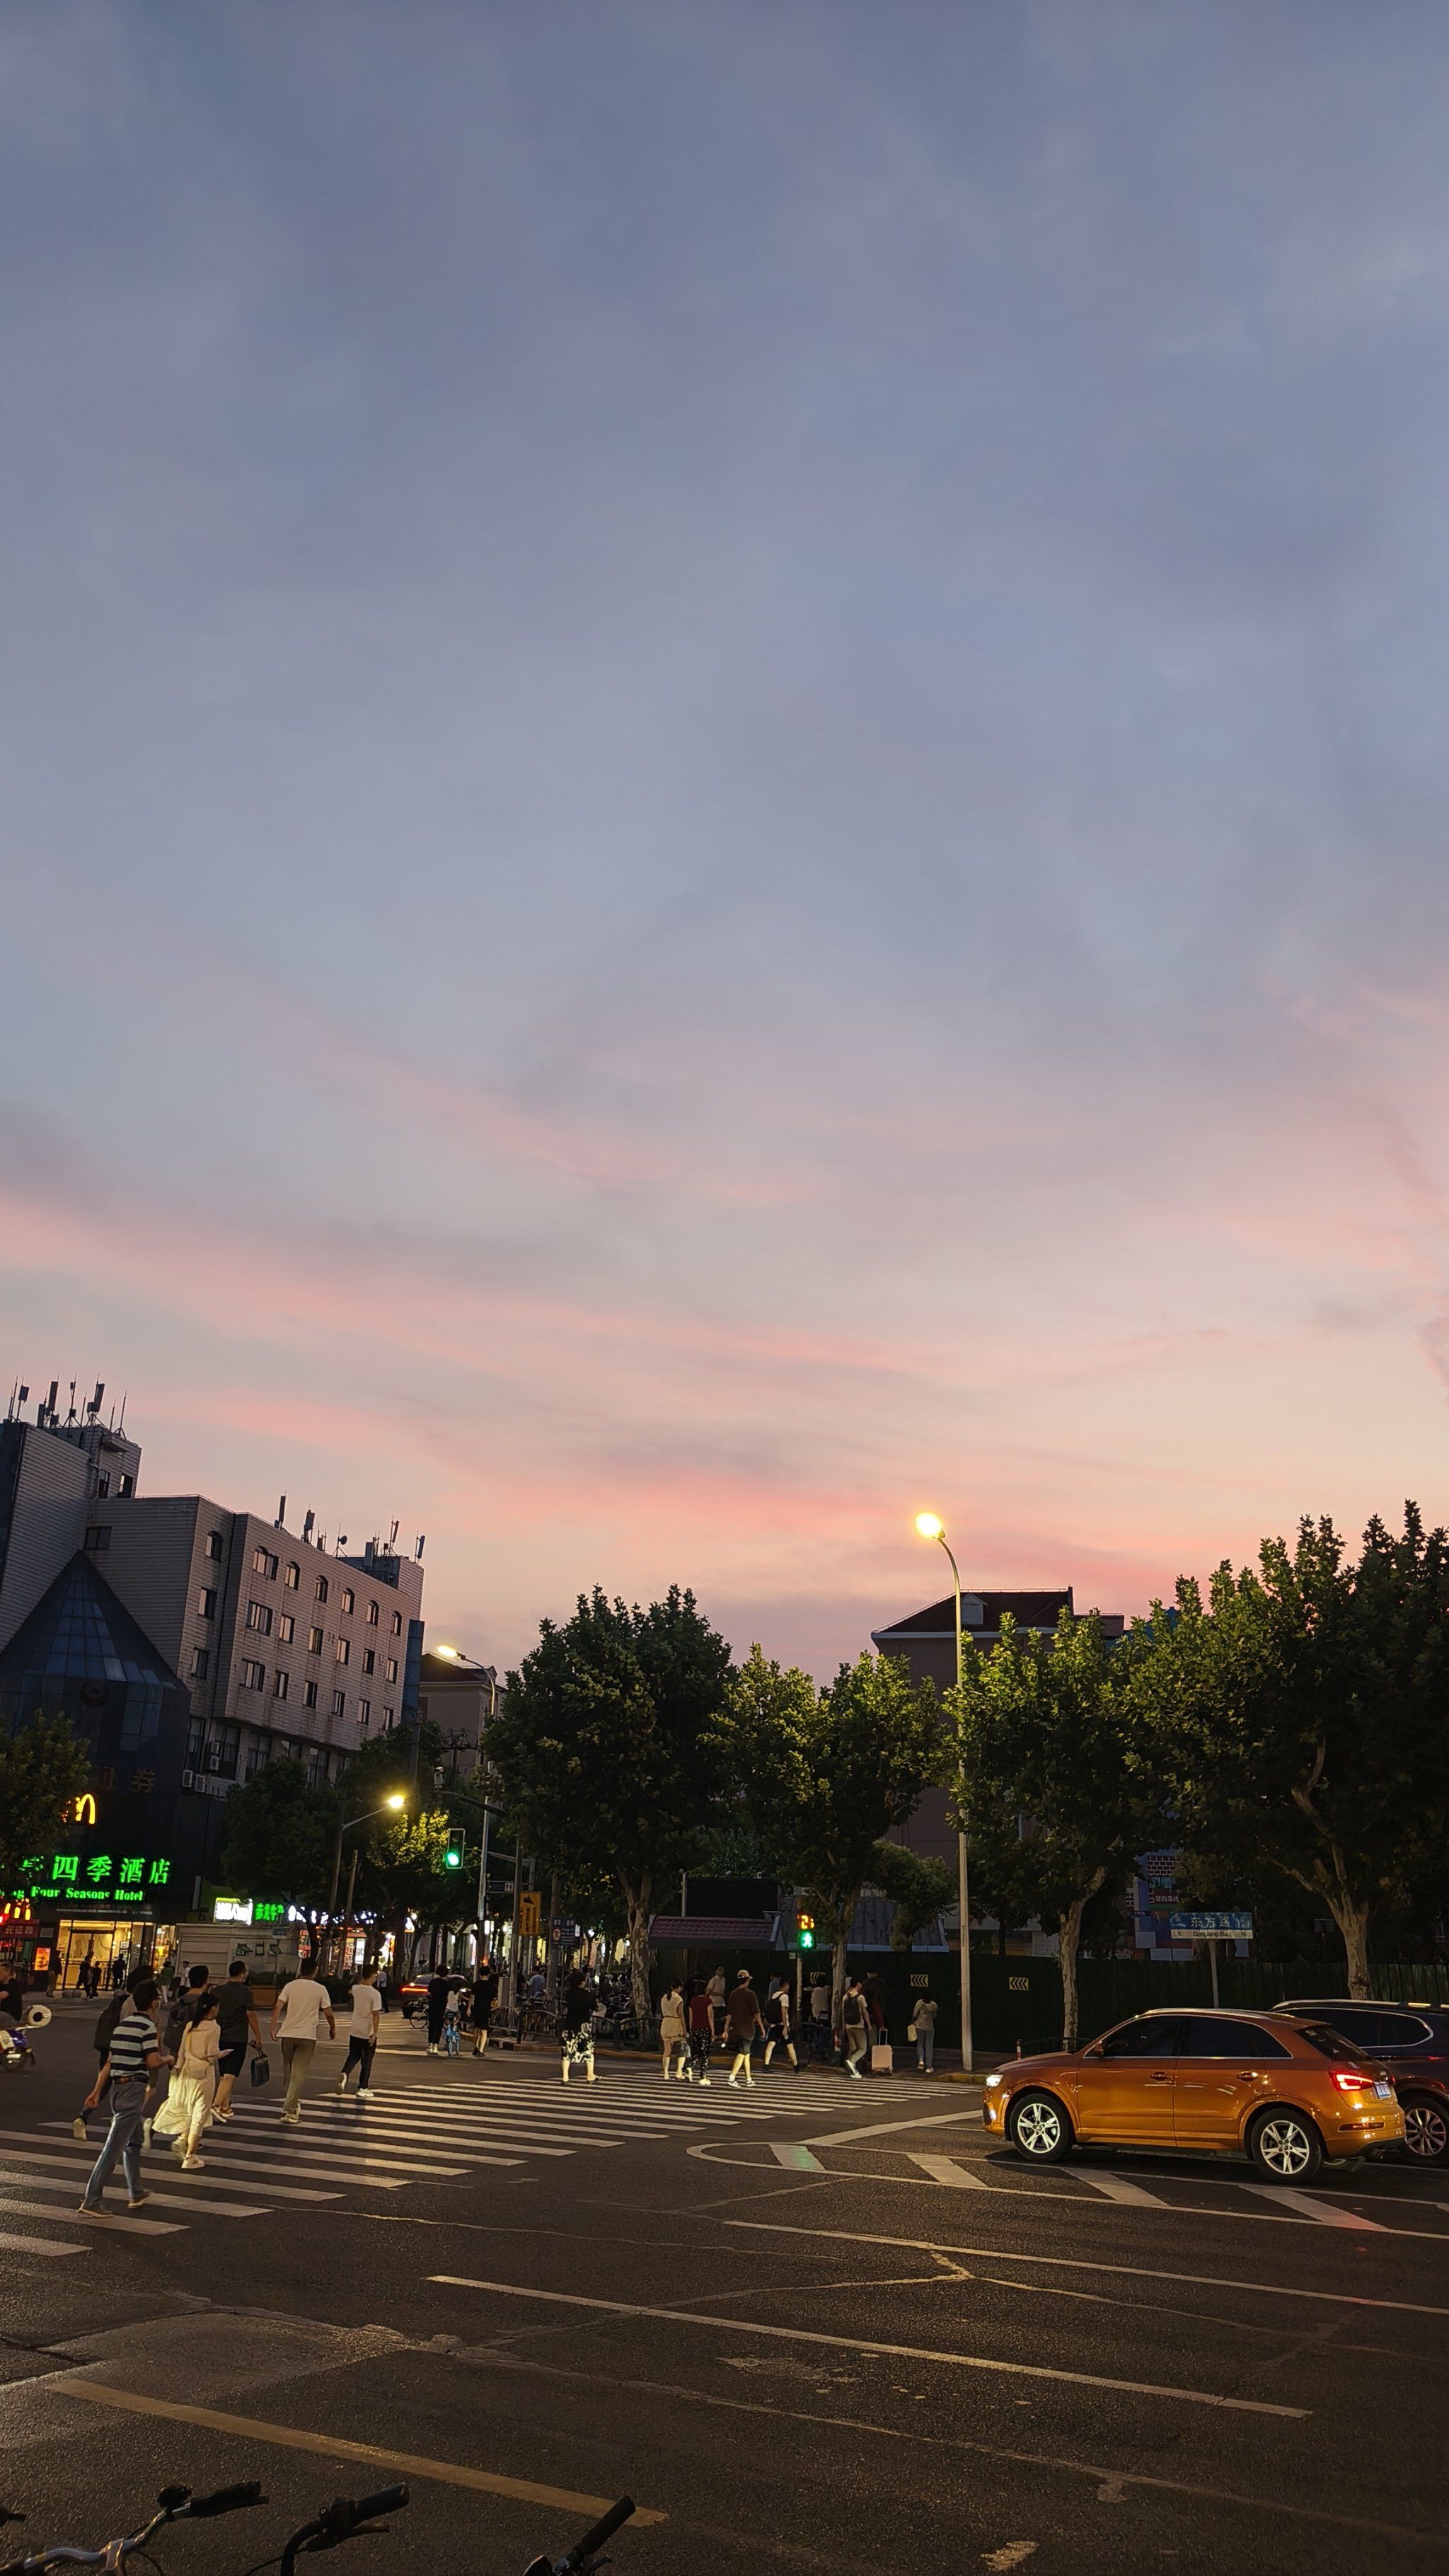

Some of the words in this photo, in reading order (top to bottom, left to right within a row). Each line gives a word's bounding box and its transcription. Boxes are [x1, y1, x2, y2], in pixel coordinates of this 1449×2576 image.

[31, 1885, 60, 1898] Four
[66, 1887, 110, 1900] Seasons
[115, 1889, 144, 1902] Hotel
[1190, 1915, 1230, 1929] 东方路
